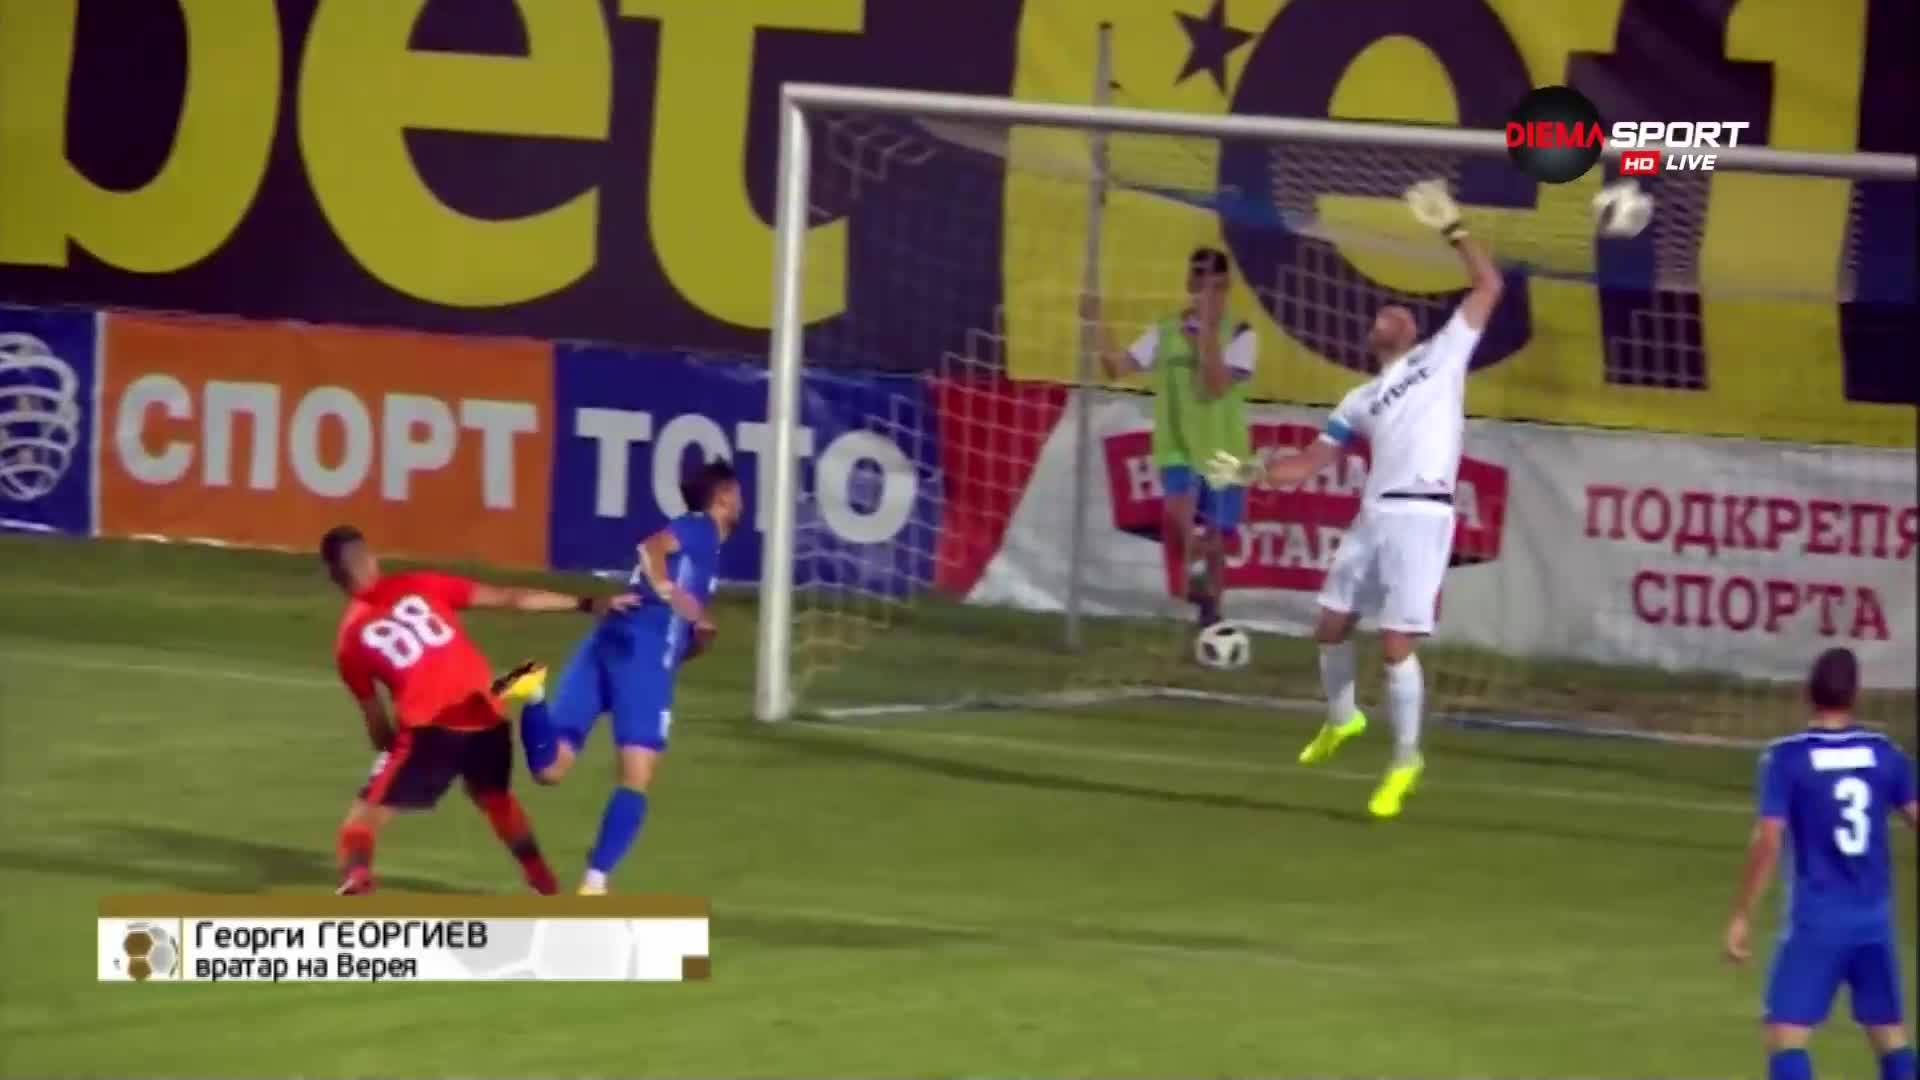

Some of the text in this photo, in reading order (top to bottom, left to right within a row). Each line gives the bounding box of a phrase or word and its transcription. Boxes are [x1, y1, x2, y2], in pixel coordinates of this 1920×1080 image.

[114, 373, 918, 544] СПОРТ ТОТО
[361, 594, 455, 669] 88
[1630, 570, 1890, 641] СПОРТА
[1833, 776, 1872, 857] 3
